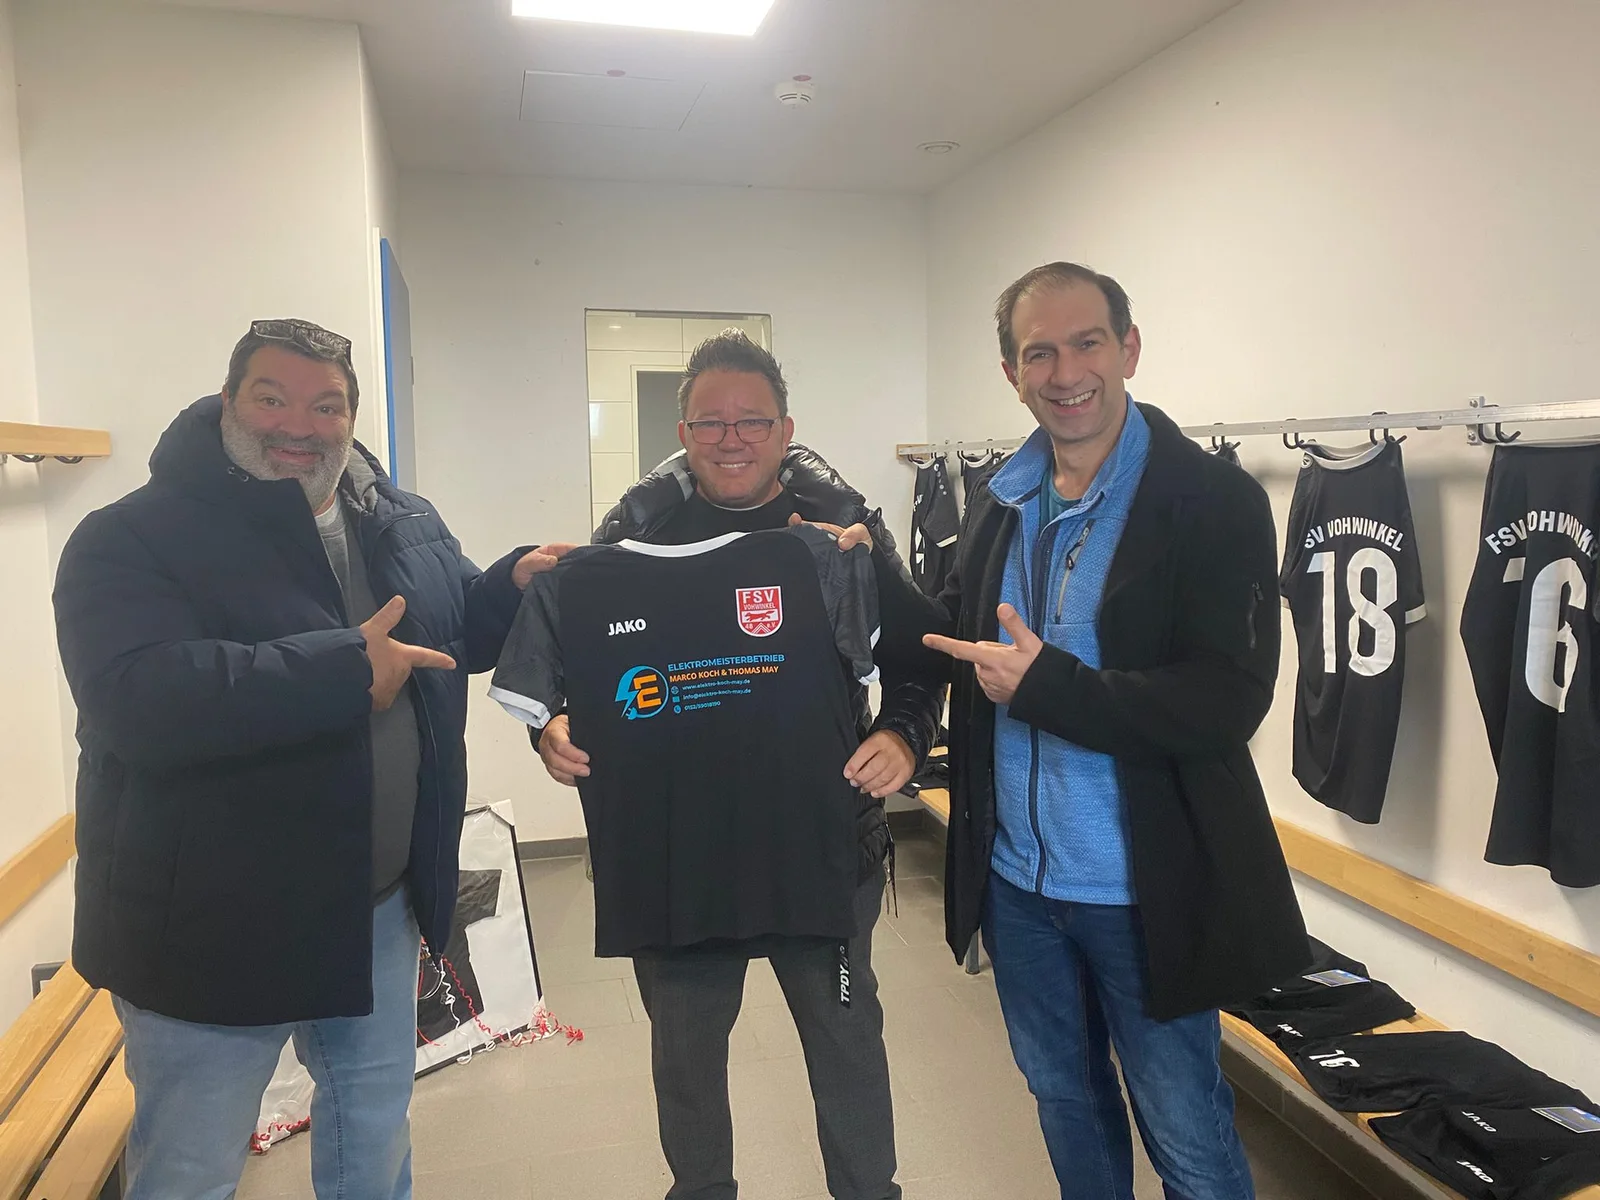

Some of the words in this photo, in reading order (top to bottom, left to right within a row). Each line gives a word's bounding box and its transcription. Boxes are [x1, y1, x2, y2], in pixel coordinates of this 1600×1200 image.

[1327, 516, 1404, 552] VOHWINKEL
[1484, 519, 1528, 555] FSV
[742, 589, 775, 604] FSV
[743, 602, 776, 611] VOHWINKEL
[1306, 547, 1398, 677] 18
[608, 618, 648, 636] JAKO
[667, 654, 785, 672] ELEKTROMEISTERBETRIEB
[669, 672, 697, 682] MARCO
[698, 669, 720, 679] KOCH
[721, 668, 727, 676] &
[728, 666, 761, 676] THOMAS
[761, 665, 779, 674] MAY
[633, 674, 662, 709] E
[682, 679, 751, 691] www.elektro-koch-may.de
[1461, 1110, 1497, 1133] JAKO
